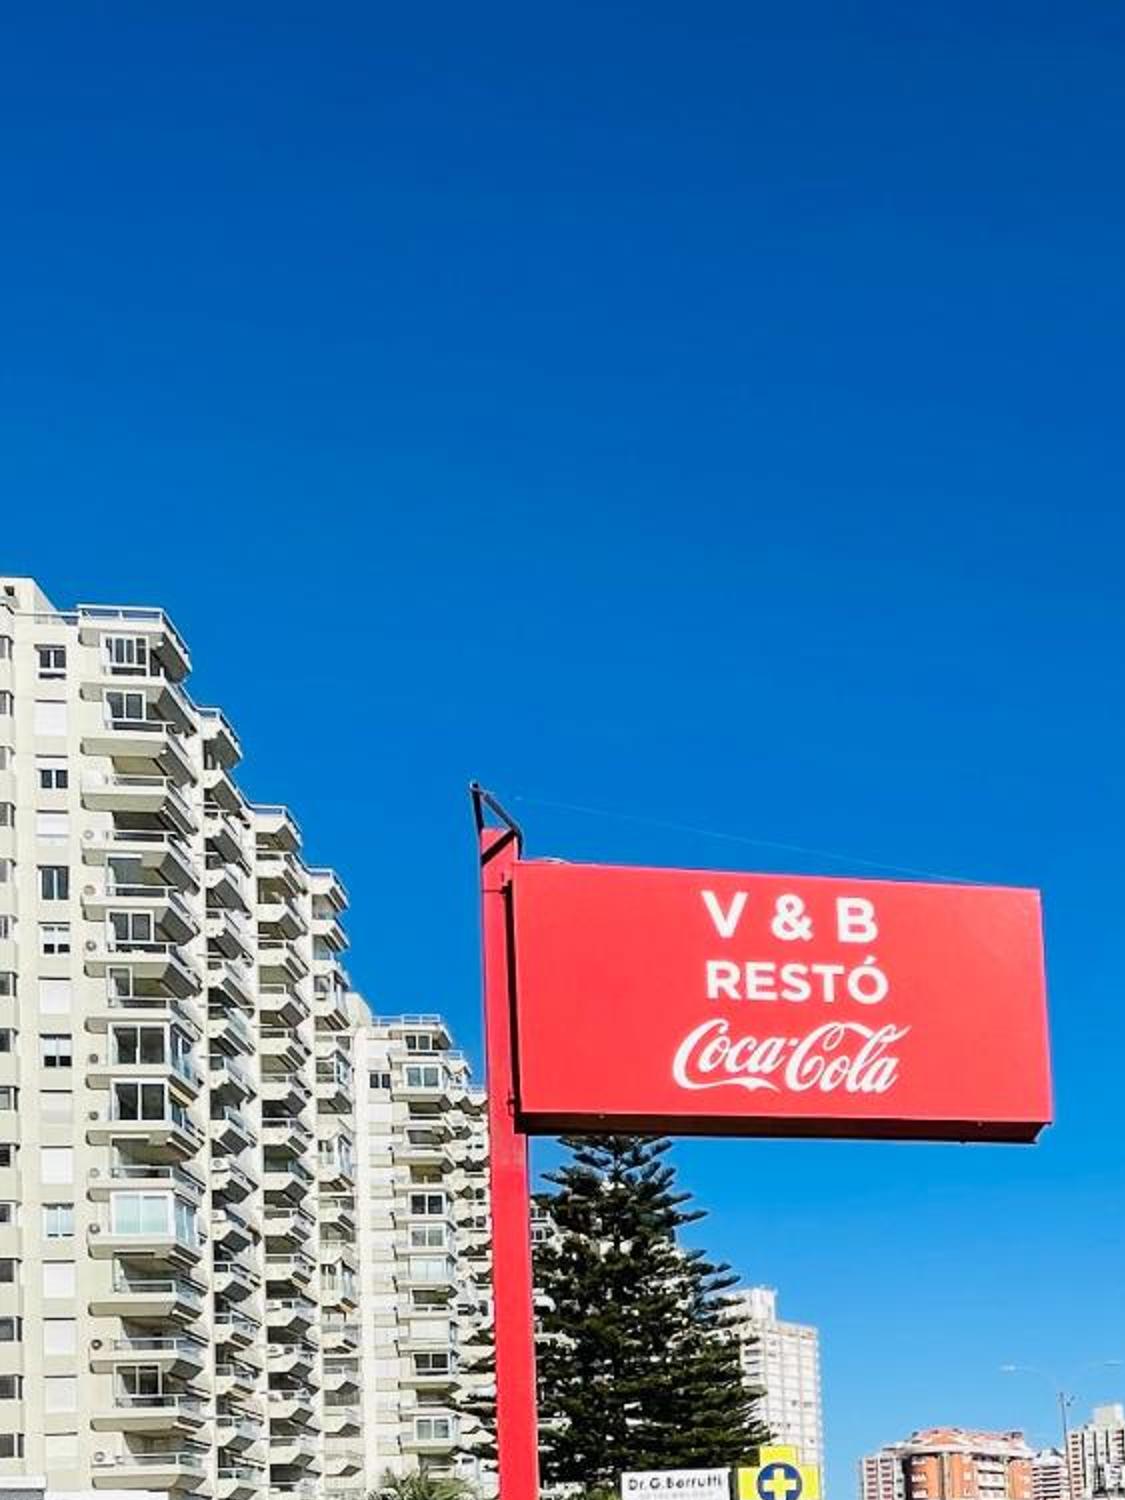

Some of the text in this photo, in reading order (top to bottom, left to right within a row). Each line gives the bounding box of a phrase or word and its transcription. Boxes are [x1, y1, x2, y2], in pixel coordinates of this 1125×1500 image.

[700, 890, 879, 944] V & B
[705, 954, 889, 1005] RESTÓ
[672, 1018, 912, 1093] Coca-Cola
